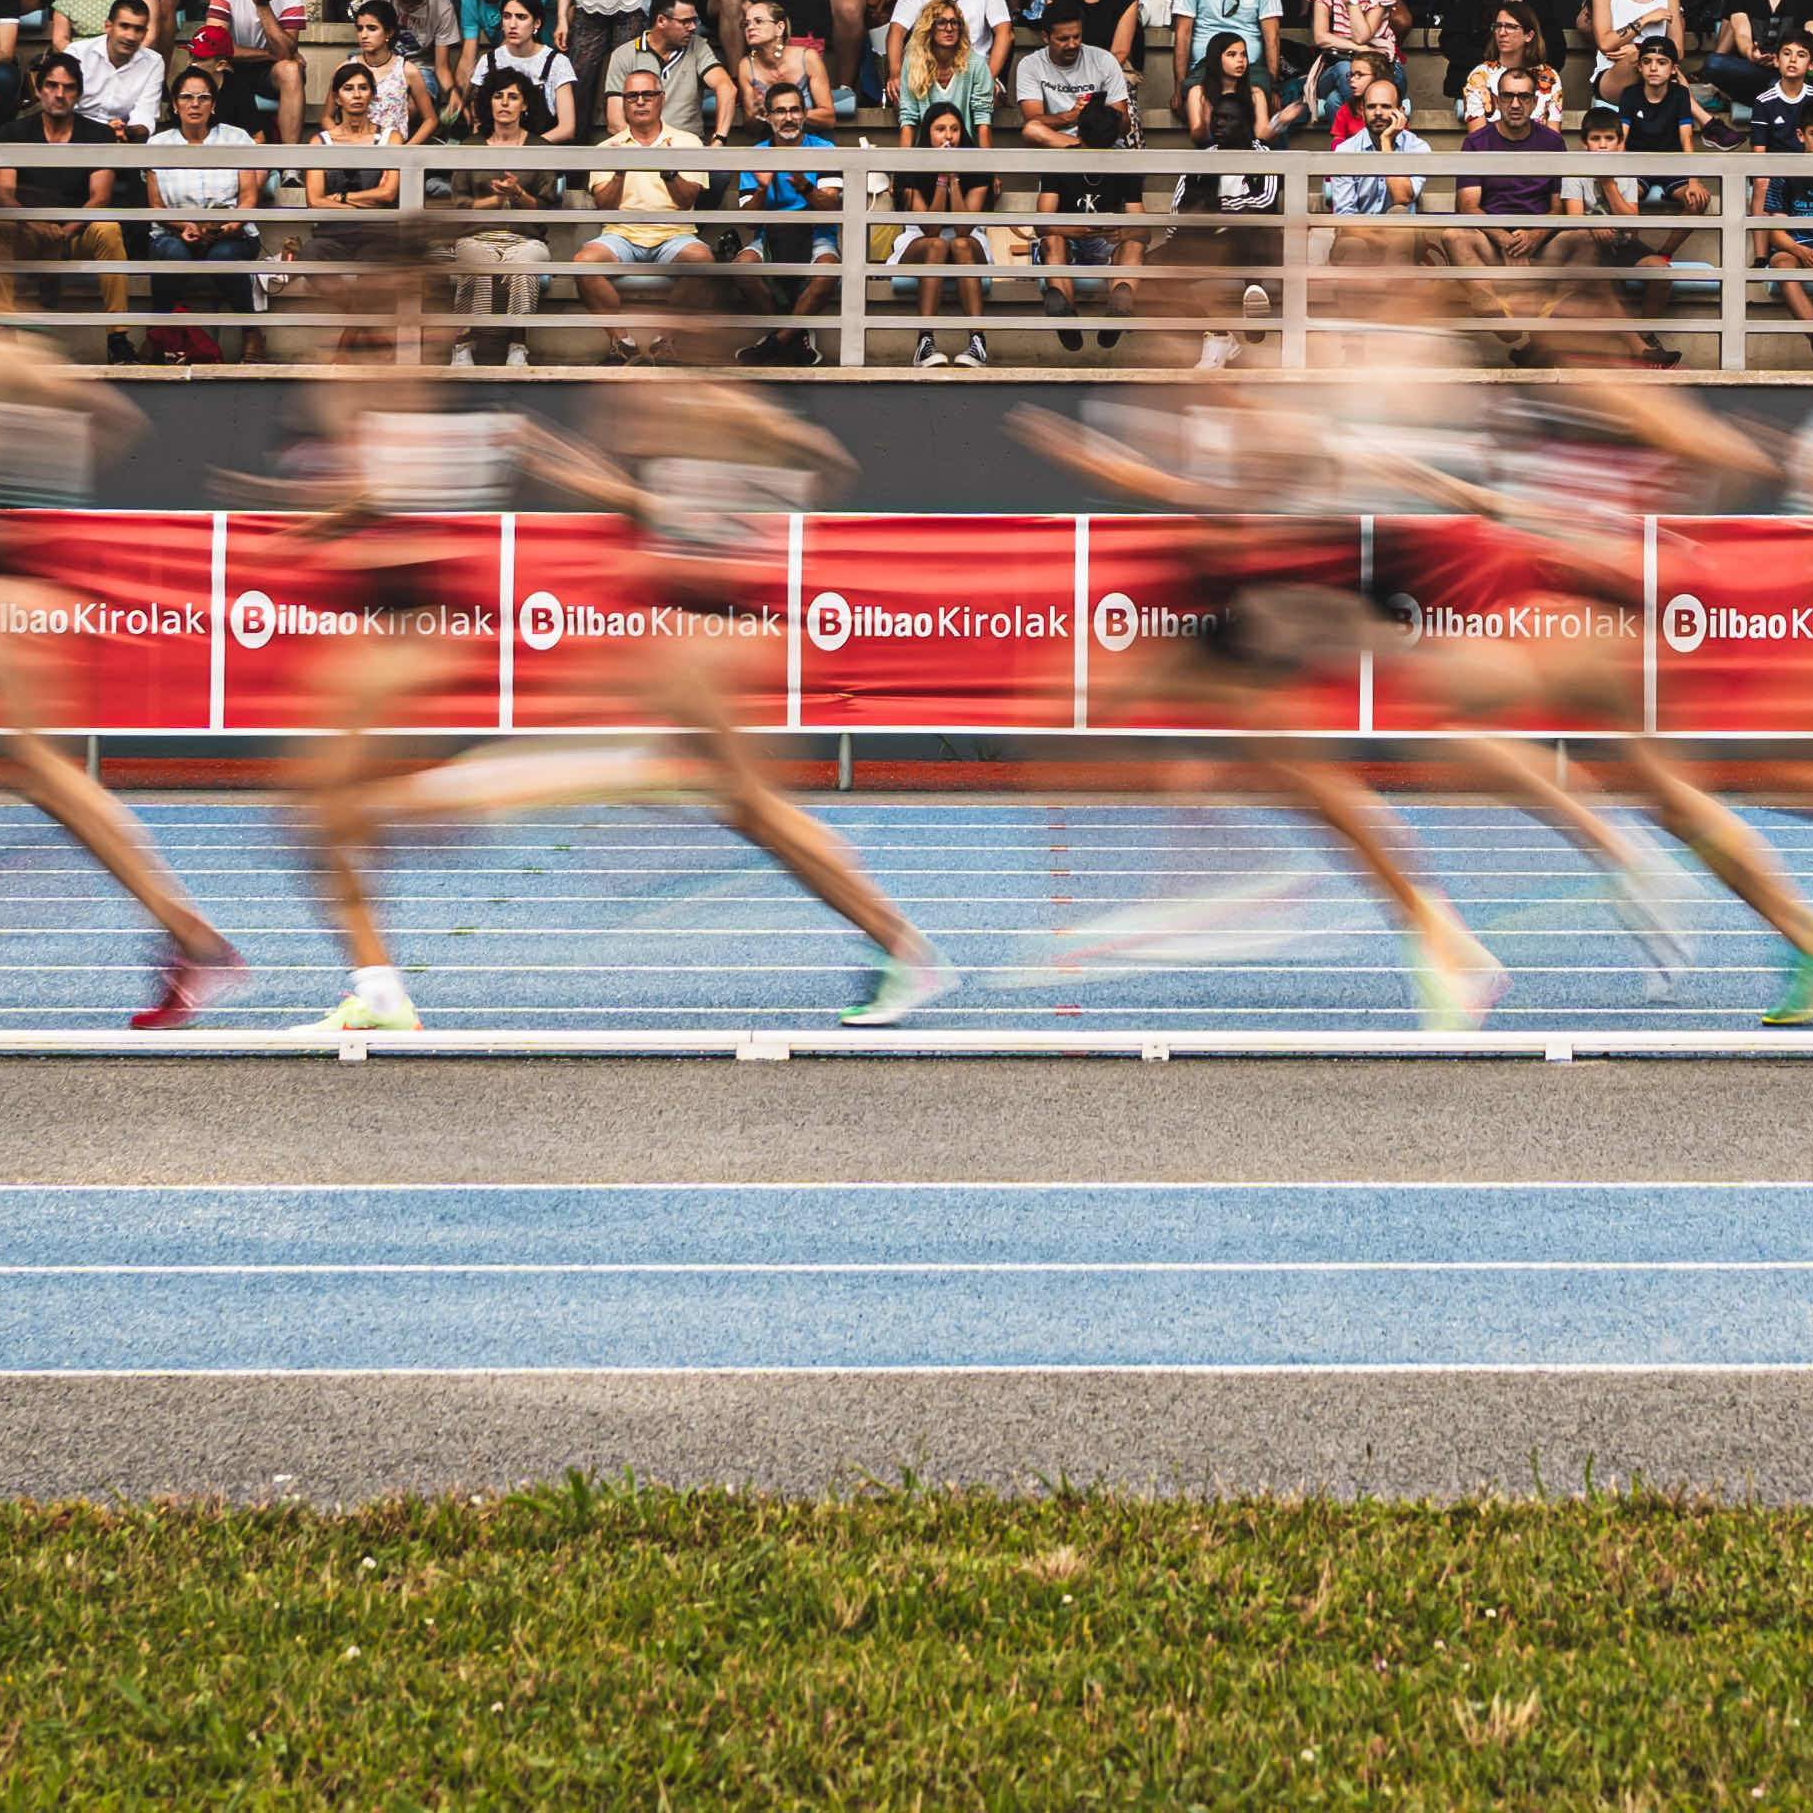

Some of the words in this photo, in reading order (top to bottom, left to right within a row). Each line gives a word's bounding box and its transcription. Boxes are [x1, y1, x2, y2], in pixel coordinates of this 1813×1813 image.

[239, 602, 495, 639] BilbaoKirolak
[528, 602, 781, 639] BilbaoKirolak
[816, 602, 1068, 640] BilbaoKirolak
